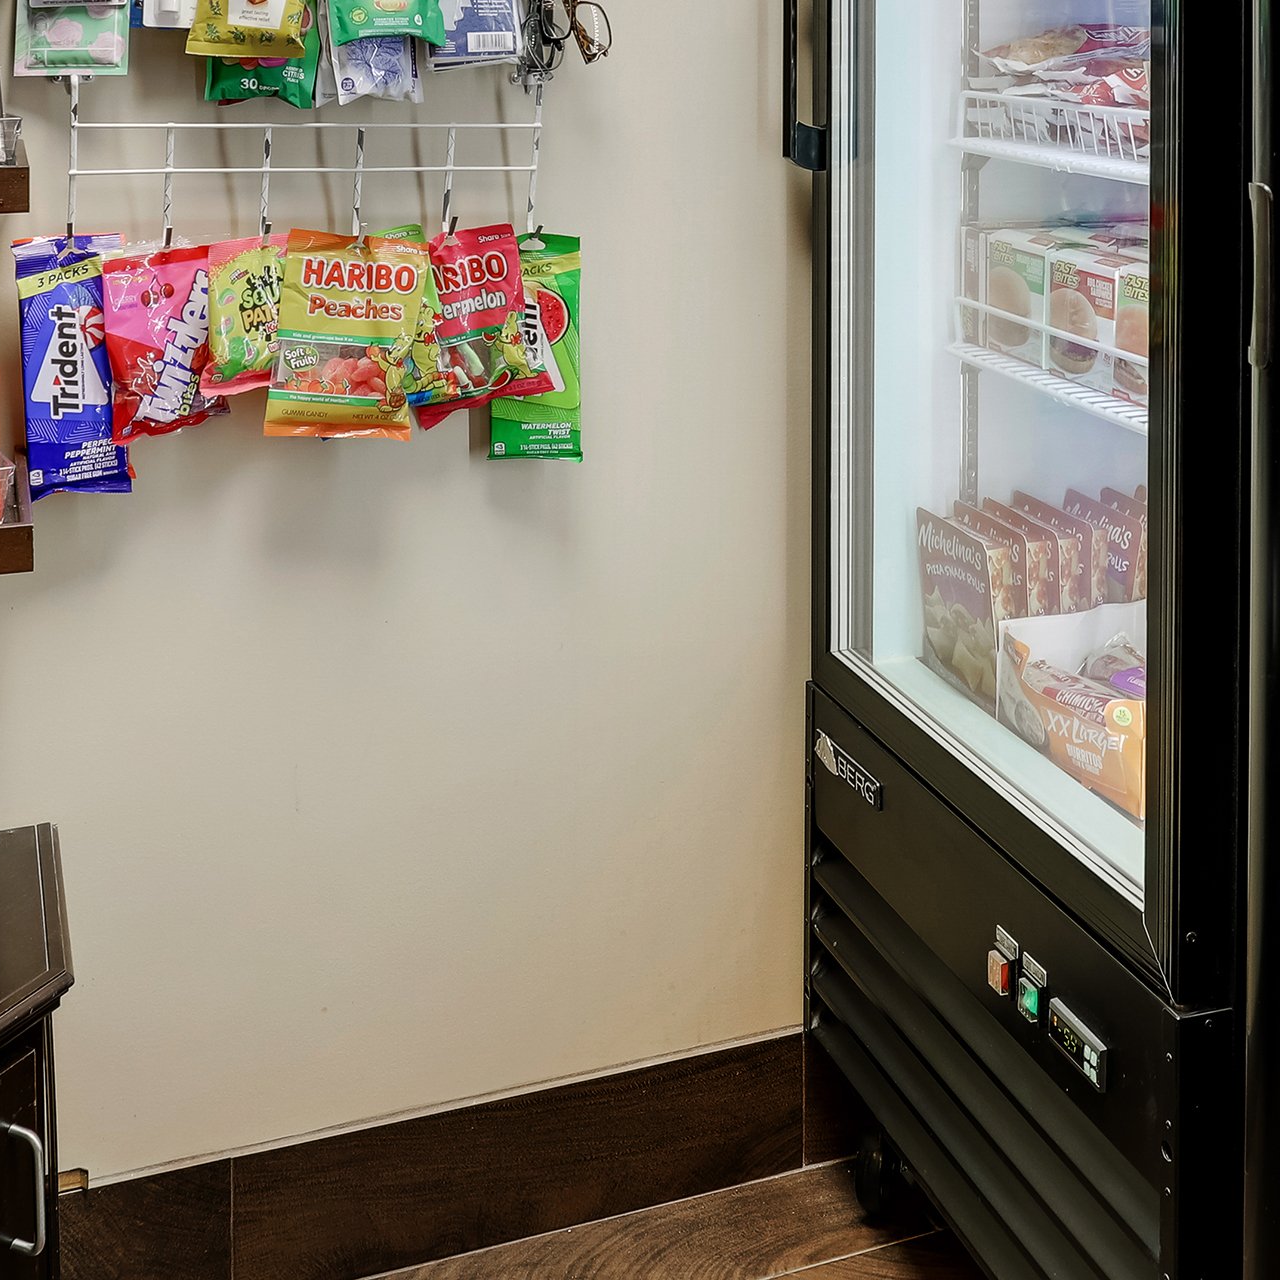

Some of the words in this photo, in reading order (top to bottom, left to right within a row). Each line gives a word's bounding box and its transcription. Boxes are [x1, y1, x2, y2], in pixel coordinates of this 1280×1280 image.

[240, 77, 258, 90] 30
[992, 240, 1013, 253] FAST
[992, 250, 1015, 265] BITES
[1054, 260, 1077, 272] FAST
[37, 277, 44, 288] 3
[47, 264, 89, 285] PACKS
[302, 257, 417, 294] HARIBO
[1054, 270, 1080, 288] BITES
[307, 295, 404, 321] Peaches
[52, 306, 81, 414] Trident
[290, 354, 318, 370] Fruity
[520, 421, 572, 432] WATERMELON
[548, 428, 571, 437] TWIST
[64, 444, 117, 460] PEPPERMINT
[918, 521, 983, 571] Michelina's
[1066, 743, 1104, 770] BURRITOS
